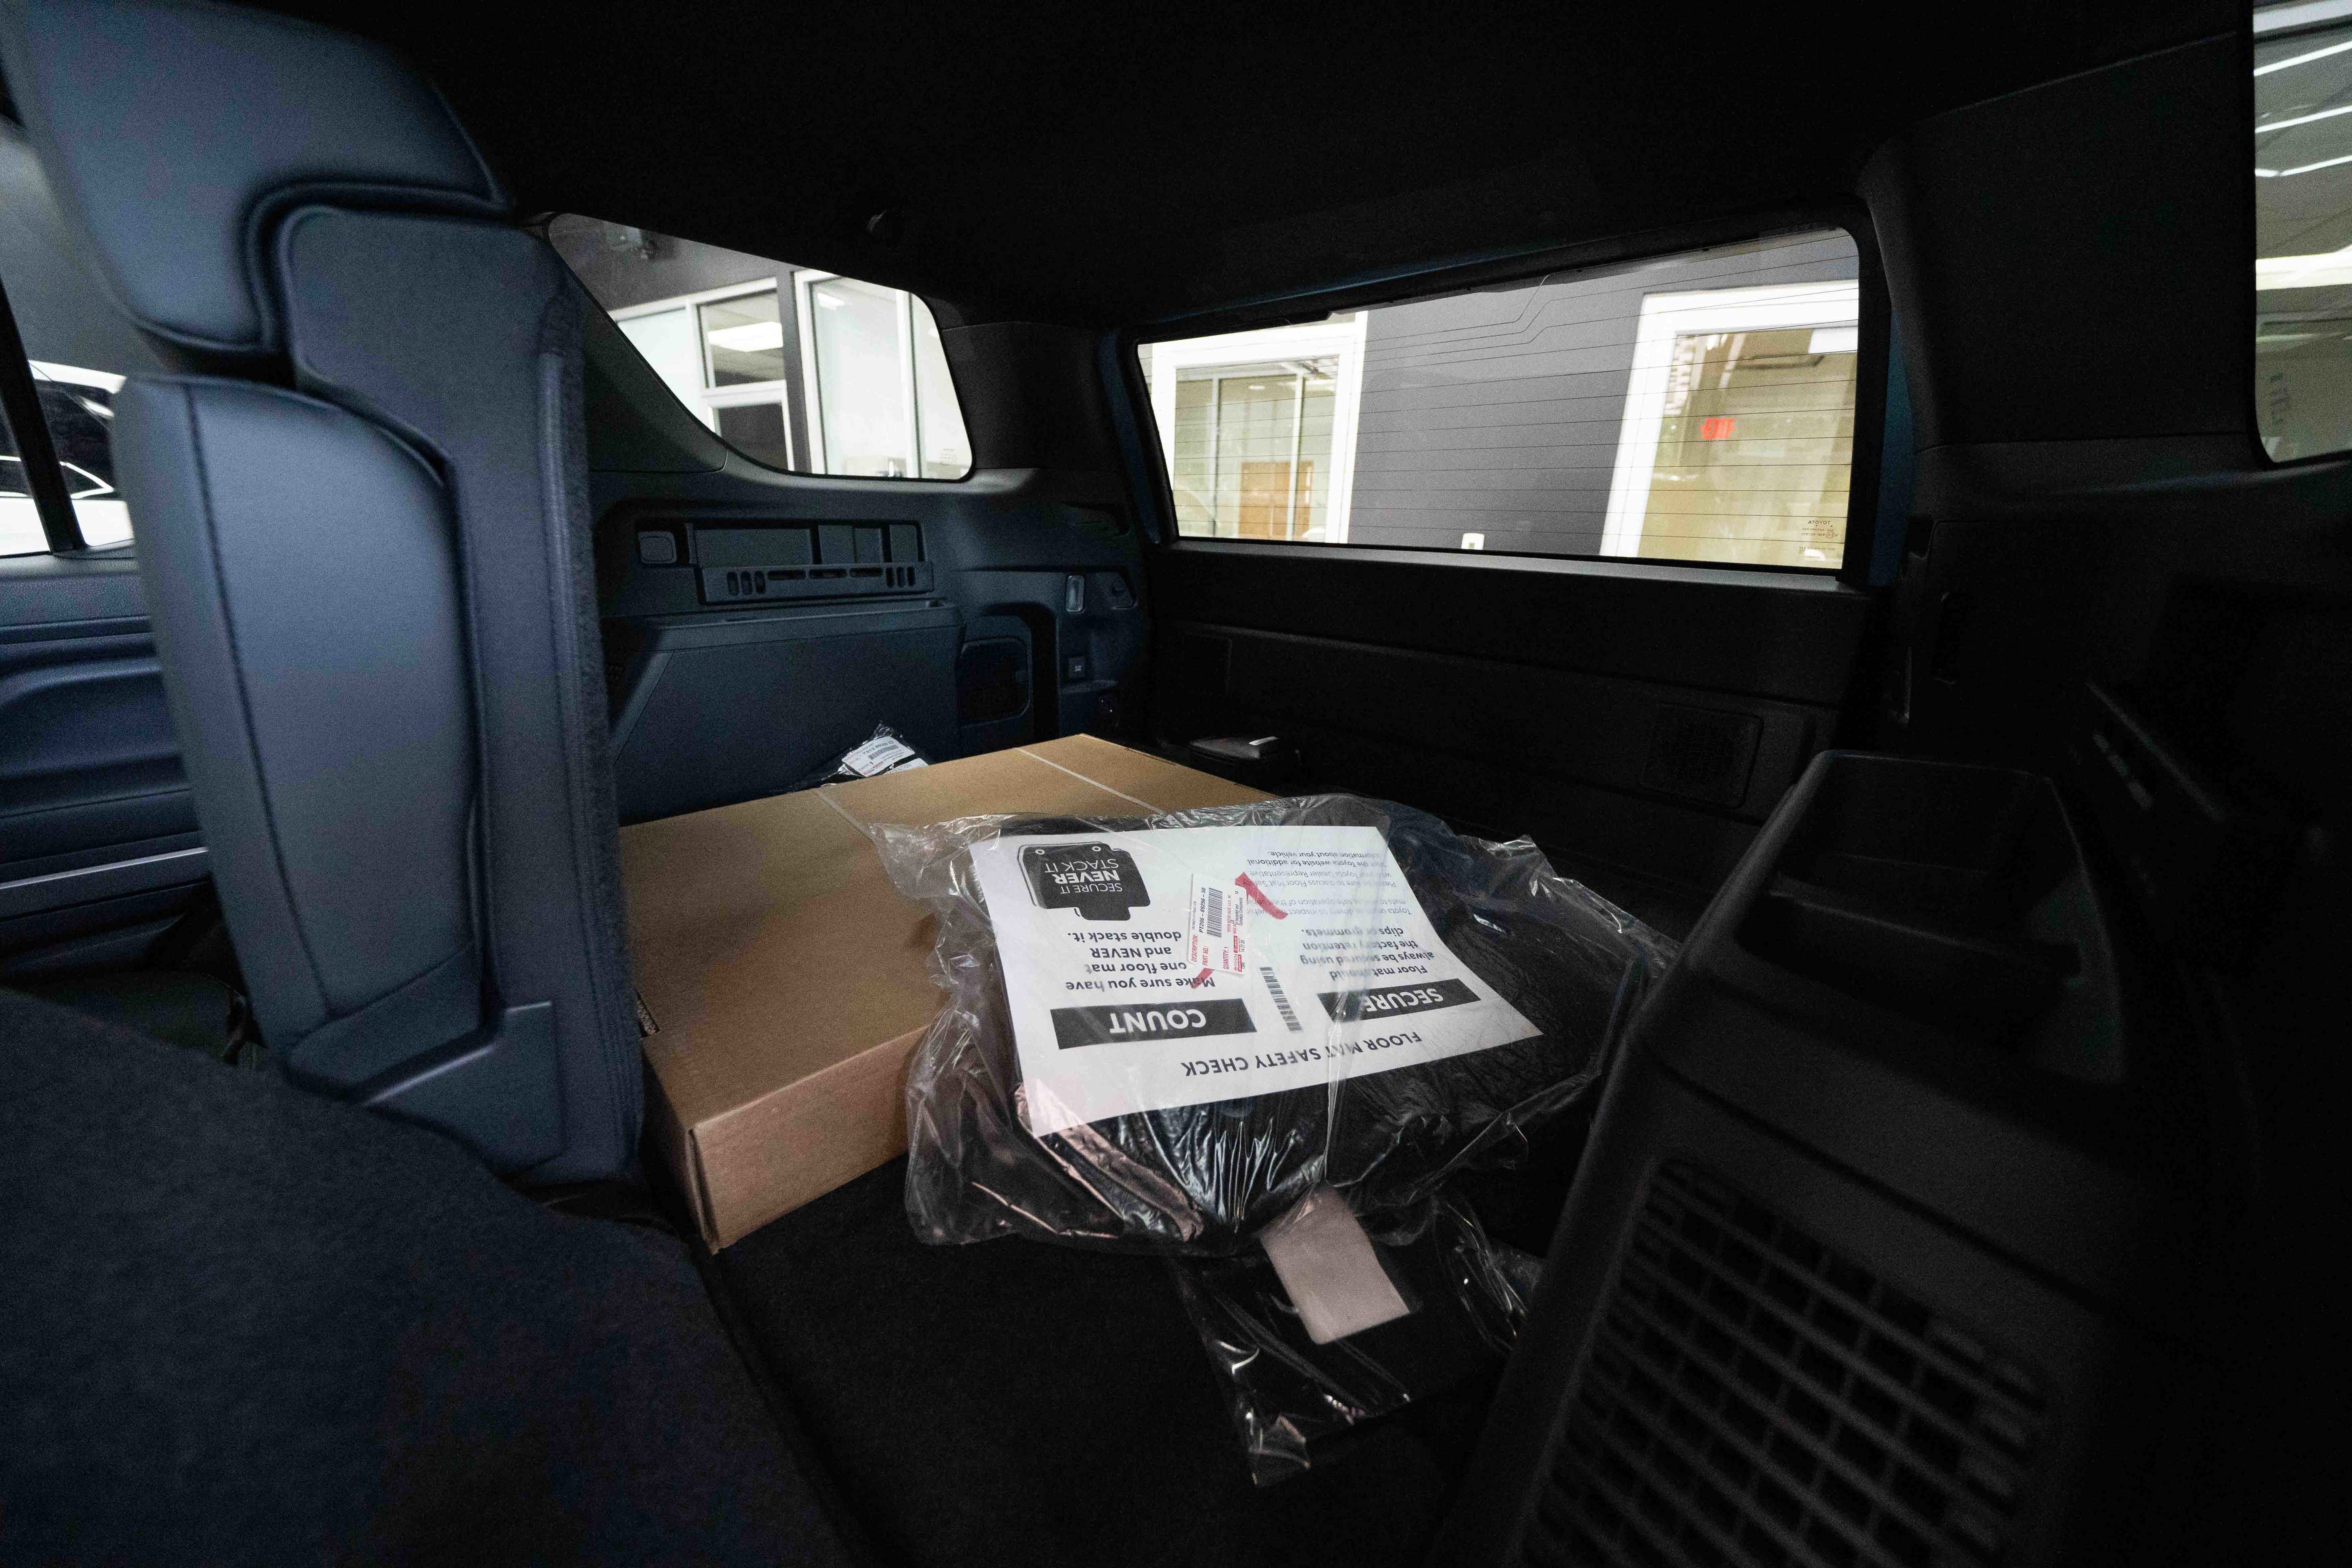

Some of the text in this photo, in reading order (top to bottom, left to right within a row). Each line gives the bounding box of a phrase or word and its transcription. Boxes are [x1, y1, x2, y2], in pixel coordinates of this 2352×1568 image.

[1045, 859, 1119, 873] STACK IT
[1051, 870, 1120, 884] NEVER
[1060, 883, 1123, 894] SECURE IT
[1068, 931, 1182, 943] double stack it.
[1378, 926, 1404, 937] clips
[1399, 940, 1418, 949] the
[1089, 947, 1172, 958] and NEVER
[1397, 951, 1435, 962] always
[1300, 955, 1334, 967] using
[1381, 954, 1399, 963] be
[1084, 962, 1187, 974] one floor mat
[1372, 967, 1396, 977] mat
[1396, 965, 1428, 975] Floor
[1065, 976, 1216, 992] Make sure you have
[1109, 1009, 1207, 1034] COUNT
[1180, 1032, 1422, 1077] FLOOR MAT SAFETY CHECK
